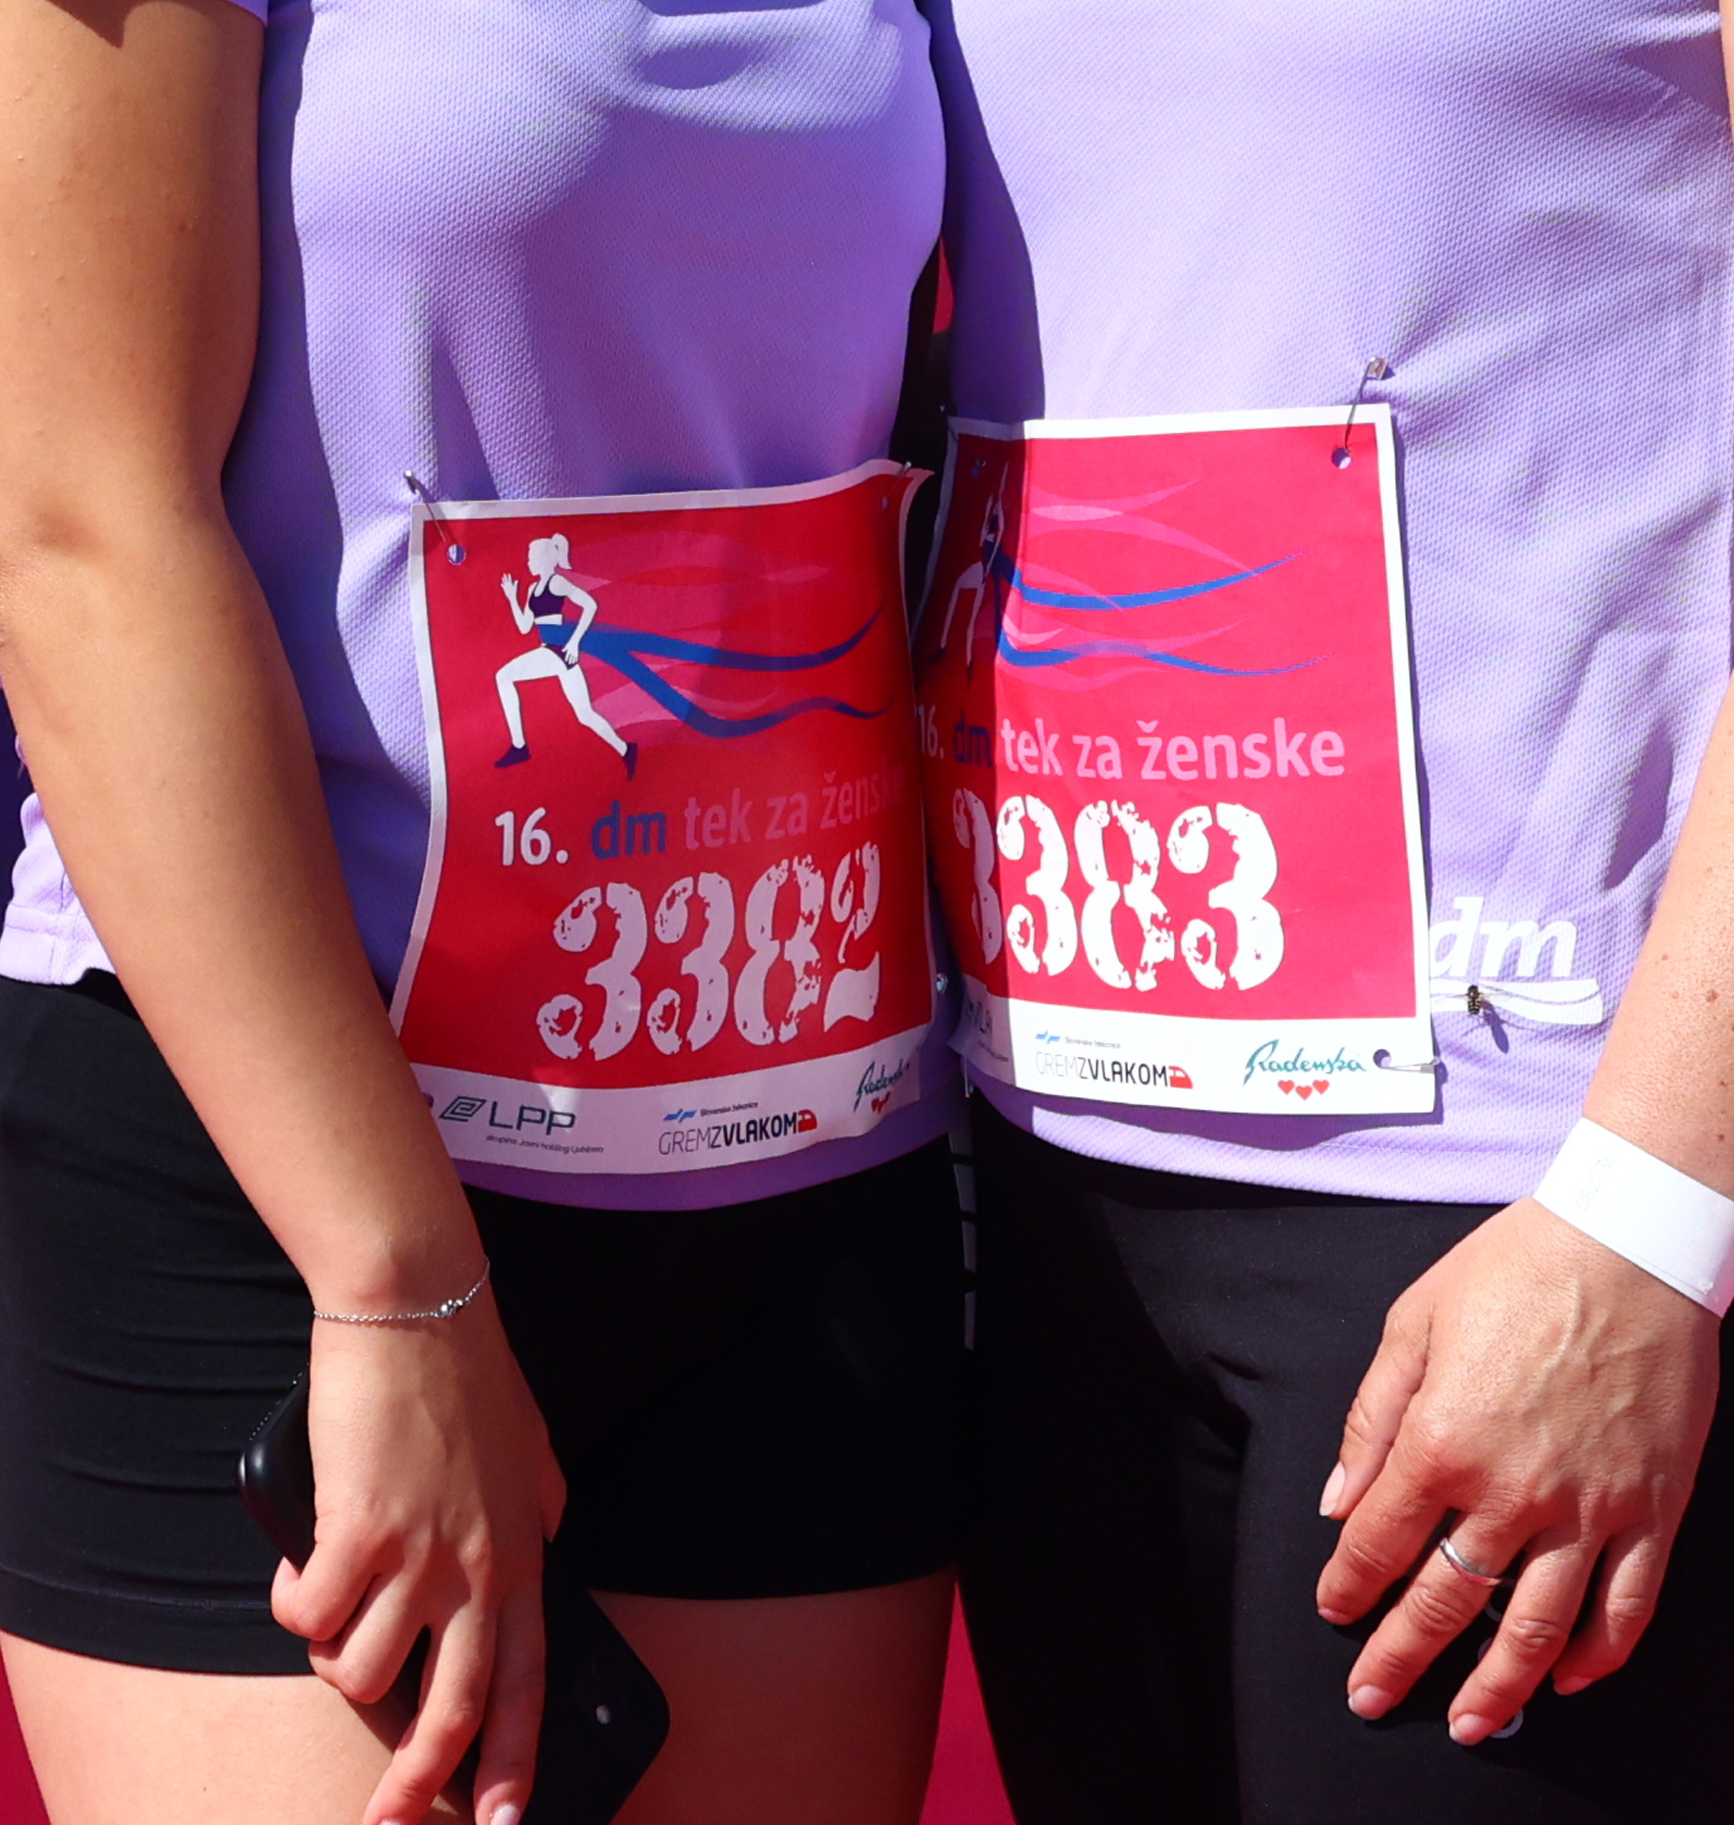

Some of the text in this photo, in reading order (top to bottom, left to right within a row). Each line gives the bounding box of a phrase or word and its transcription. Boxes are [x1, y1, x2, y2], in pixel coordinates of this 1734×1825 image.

[952, 709, 993, 768] dm
[1001, 718, 1063, 776] tek
[1072, 734, 1123, 779] za
[1136, 717, 1345, 781] ženske
[495, 754, 906, 866] 16. dm tek za ženske
[953, 788, 1285, 992] 3383
[536, 842, 881, 1061] 3382
[1429, 896, 1578, 978] dm
[1035, 1051, 1169, 1087] GREMZVLAKOM
[1243, 1039, 1367, 1086] Radenska
[489, 1101, 576, 1135] LPP
[658, 1111, 797, 1155] GREMZVLAKOM
